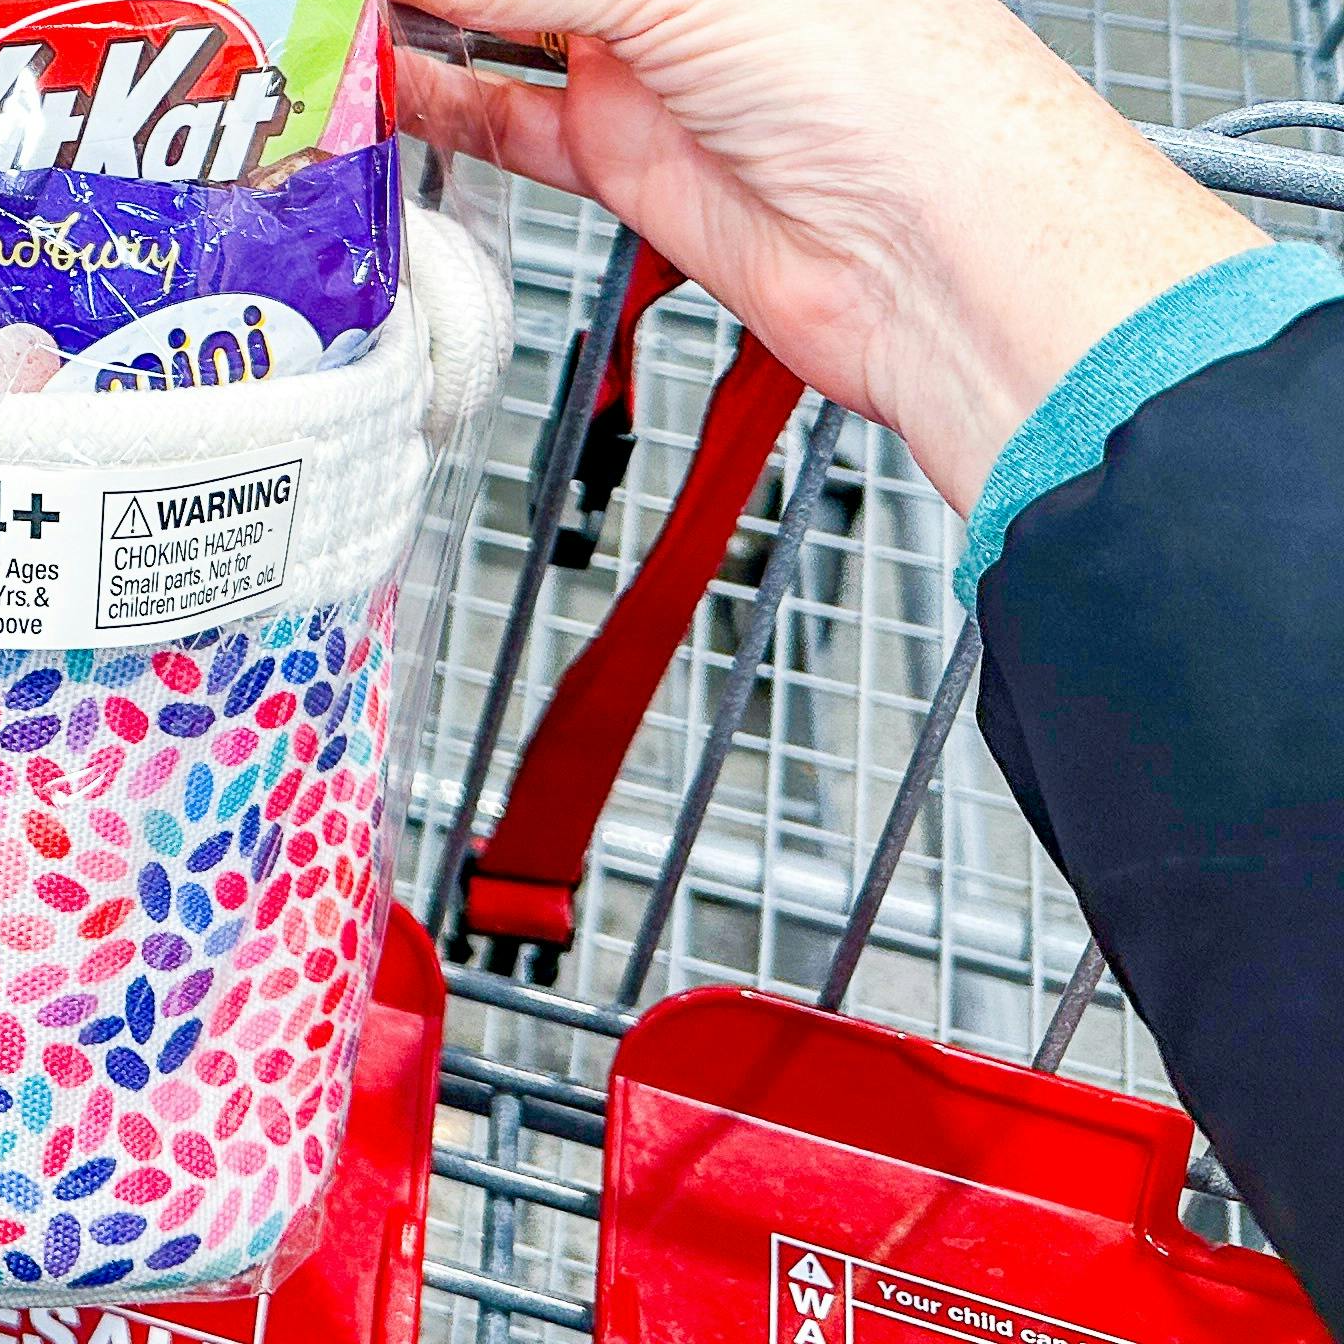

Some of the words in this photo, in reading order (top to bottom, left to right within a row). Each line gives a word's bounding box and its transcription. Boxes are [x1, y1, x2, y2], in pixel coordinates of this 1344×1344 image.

[95, 305, 270, 393] mini
[157, 475, 291, 530] WARNING
[114, 537, 199, 570] CHOKING
[204, 521, 263, 557] HAZARD
[6, 558, 59, 584] Ages
[110, 571, 159, 596] Small
[164, 567, 204, 595] parts.
[209, 560, 231, 581] Not
[234, 552, 251, 573] for
[34, 587, 49, 607] &
[109, 595, 174, 619] children
[180, 585, 218, 610] under
[221, 579, 228, 597] 4
[231, 575, 252, 599] yrs.
[877, 1280, 942, 1315] Your
[948, 1306, 1014, 1338] child
